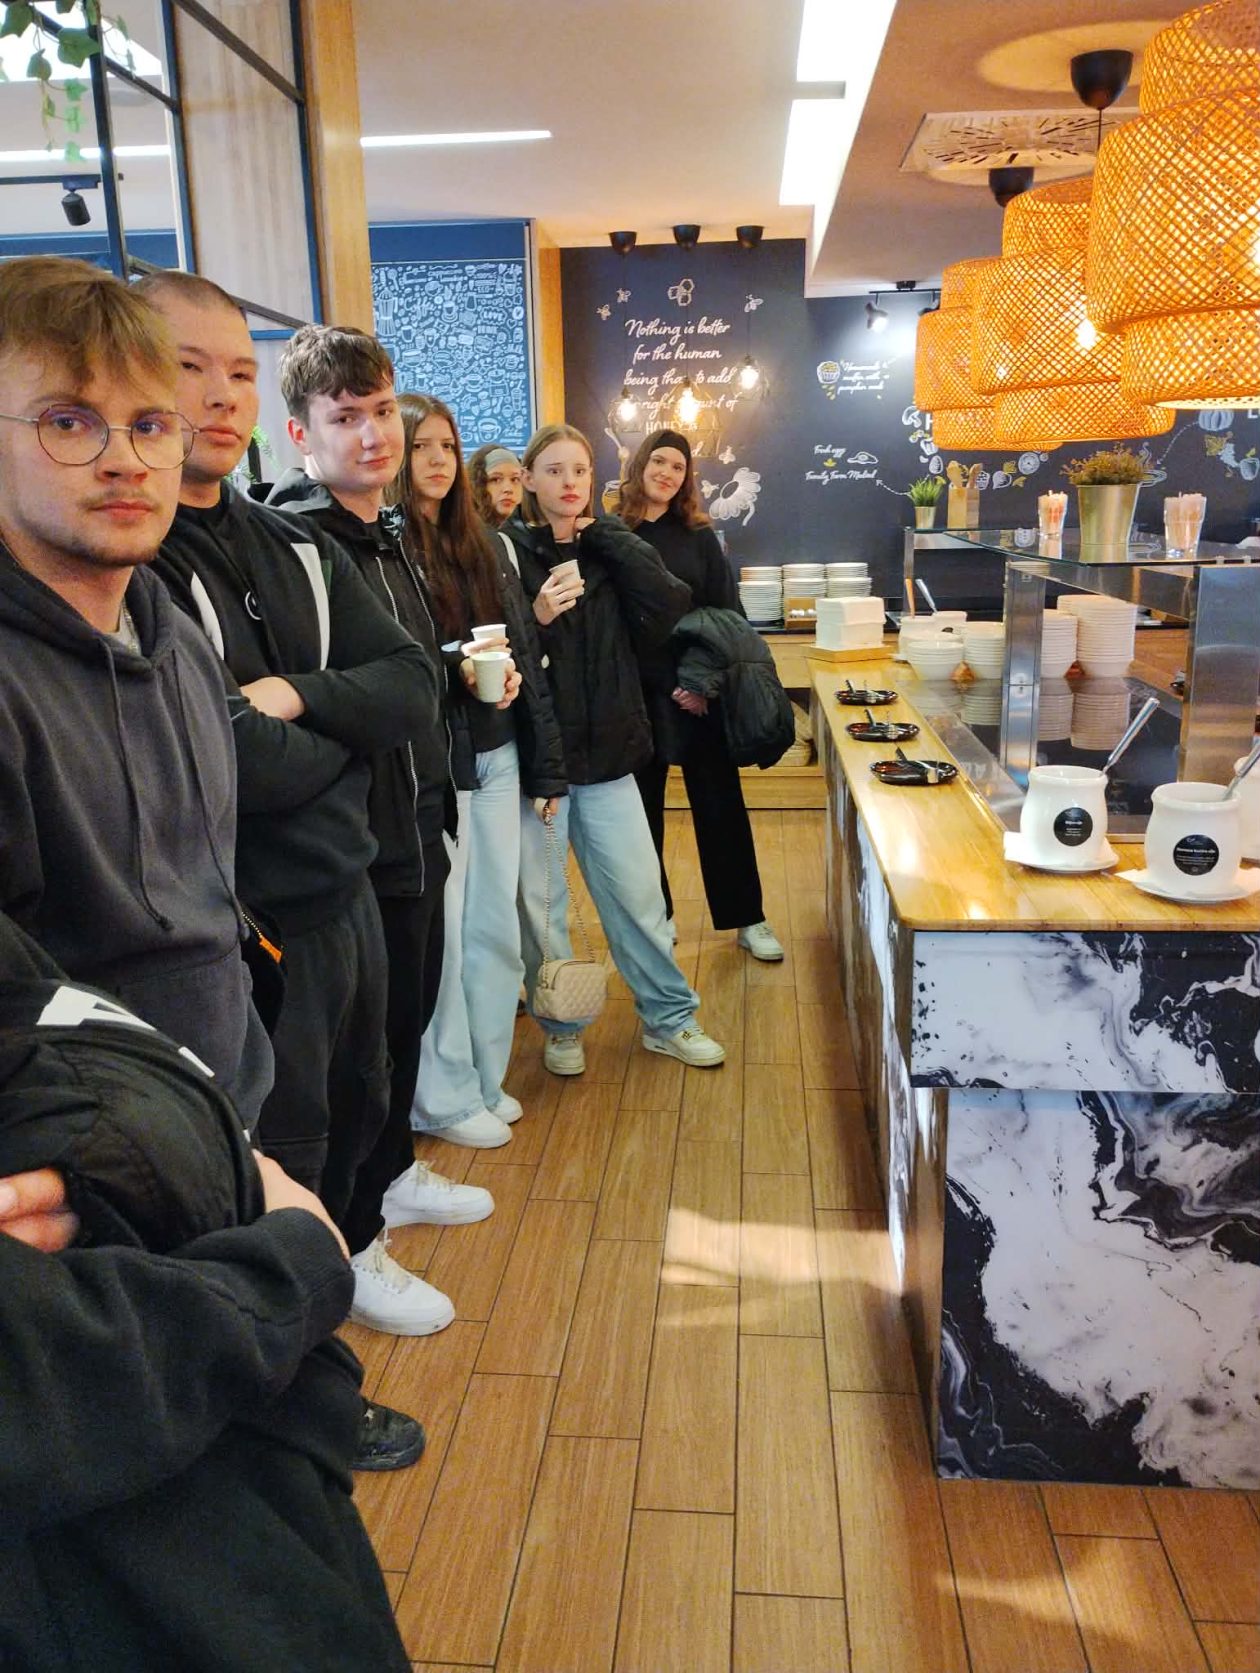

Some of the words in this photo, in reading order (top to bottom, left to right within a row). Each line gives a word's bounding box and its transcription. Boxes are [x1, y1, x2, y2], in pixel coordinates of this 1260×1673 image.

[624, 318, 681, 345] Nothing
[683, 321, 695, 334] is
[697, 316, 731, 336] better
[632, 344, 651, 365] for
[651, 343, 672, 361] the
[674, 343, 722, 360] human
[623, 369, 659, 396] being
[661, 368, 688, 385] tha
[695, 369, 705, 384] to
[725, 391, 743, 412] of
